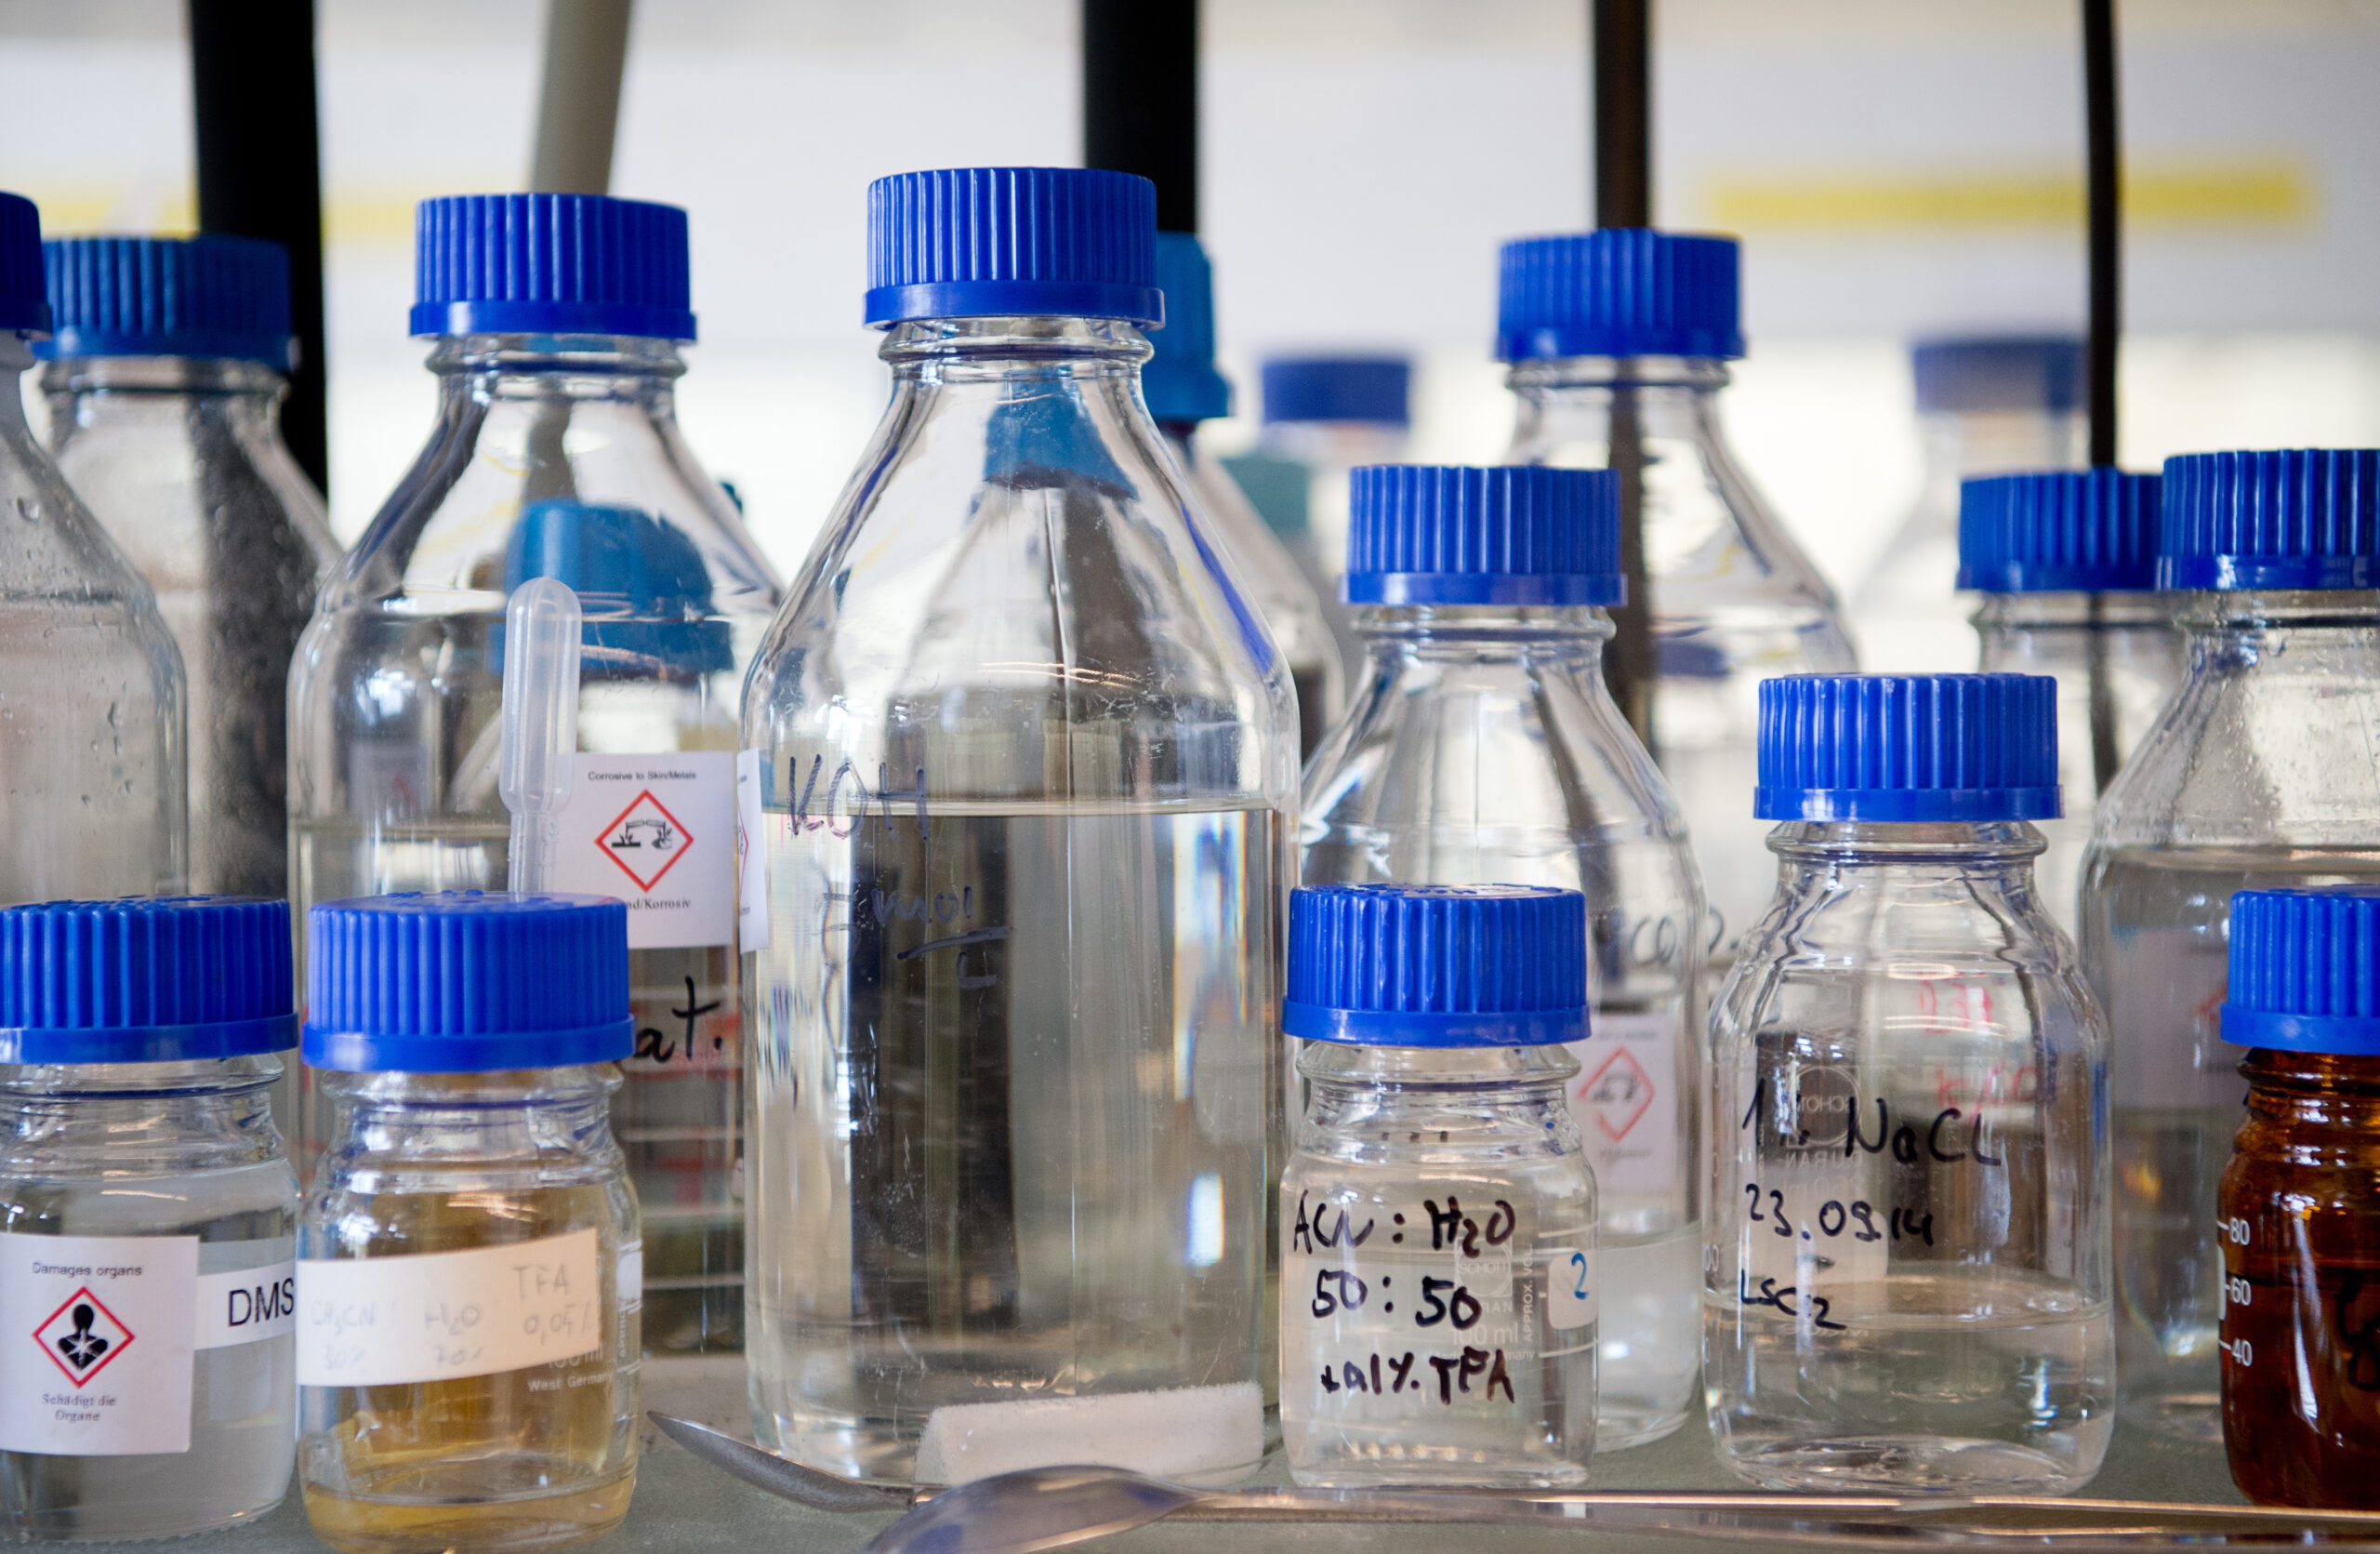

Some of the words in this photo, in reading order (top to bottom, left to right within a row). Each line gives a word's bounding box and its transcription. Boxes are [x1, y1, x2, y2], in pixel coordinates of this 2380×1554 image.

[588, 771, 633, 781] Corrosive
[636, 772, 644, 780] to
[647, 770, 697, 781] Skin/Metals
[2229, 1218, 2251, 1246] 80
[33, 1262, 91, 1278] Damages
[96, 1266, 143, 1279] organs
[1570, 1253, 1589, 1300] 2
[1312, 1268, 1368, 1319] 50
[1414, 1275, 1483, 1330] 50
[2230, 1279, 2252, 1307] 60
[2231, 1340, 2253, 1368] 40
[98, 1394, 117, 1406] die
[55, 1409, 101, 1424] Organe
